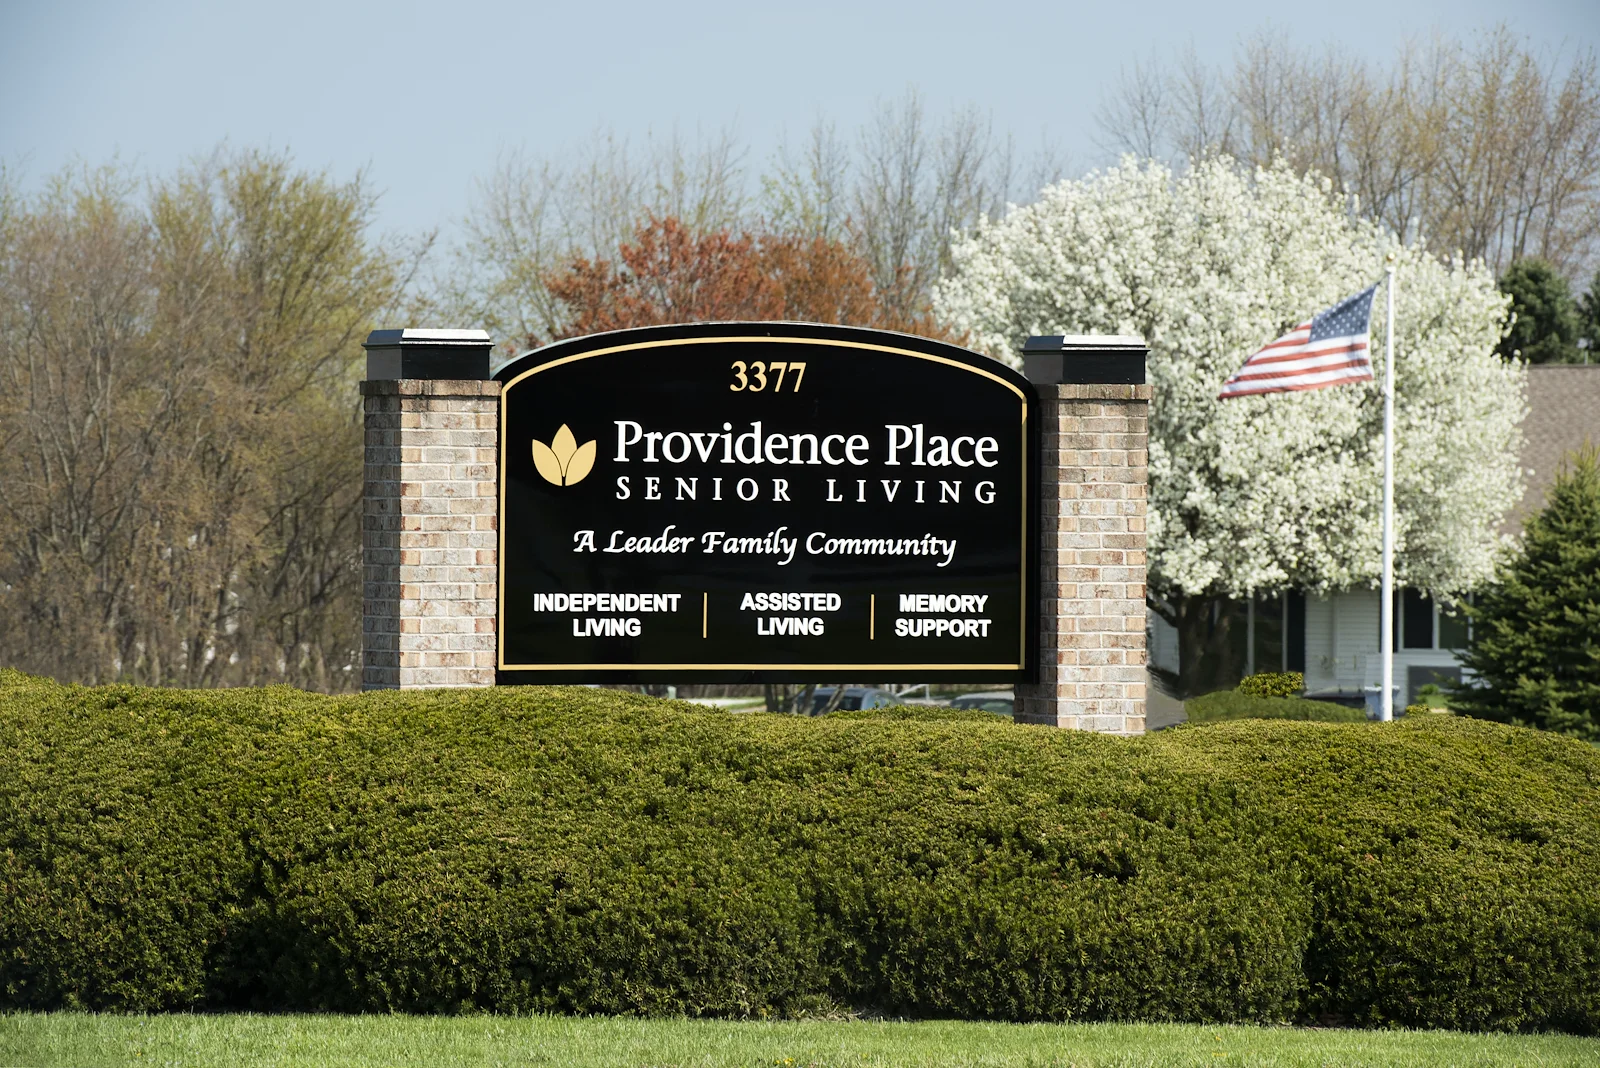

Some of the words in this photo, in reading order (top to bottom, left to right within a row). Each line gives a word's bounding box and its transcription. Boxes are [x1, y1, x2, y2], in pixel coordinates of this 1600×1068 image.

[730, 361, 806, 392] 3377
[613, 421, 869, 465] Providence
[885, 425, 998, 468] Place
[616, 476, 790, 501] SENIOR
[826, 479, 996, 504] LIVING
[573, 530, 597, 553] A
[603, 525, 695, 553] Leader
[702, 527, 797, 565] Family
[806, 532, 956, 567] Community
[534, 593, 681, 612] INDEPENDENT
[740, 593, 841, 612] ASSISTED
[900, 594, 988, 613] MEMORY
[573, 618, 641, 637] LIVING
[758, 617, 824, 636] LIVING
[895, 618, 991, 637] SUPPORT
